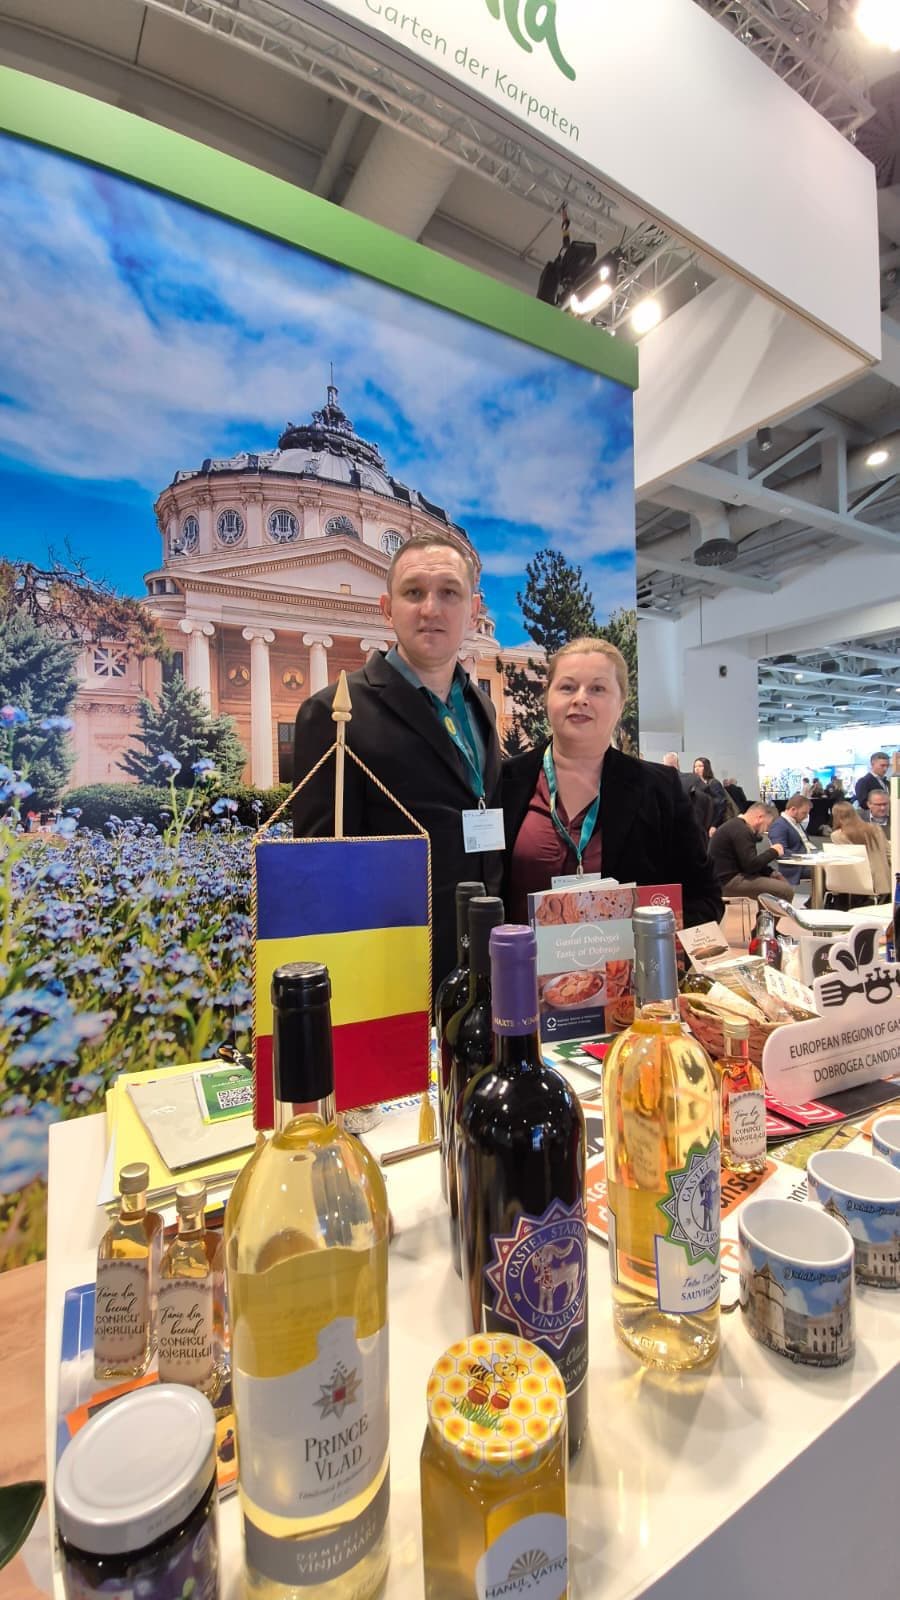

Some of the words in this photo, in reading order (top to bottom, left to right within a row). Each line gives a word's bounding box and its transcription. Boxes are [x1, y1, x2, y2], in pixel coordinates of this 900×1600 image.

[454, 47, 489, 79] der
[494, 68, 580, 142] Karpaten
[789, 1035, 840, 1059] EUROPEAN
[841, 1026, 874, 1045] REGION
[874, 1023, 886, 1037] OF
[813, 1057, 865, 1083] DOBROGEA
[304, 1412, 369, 1462] PRINCE
[314, 1443, 363, 1482] VLAD
[484, 1577, 528, 1599] HANUL
